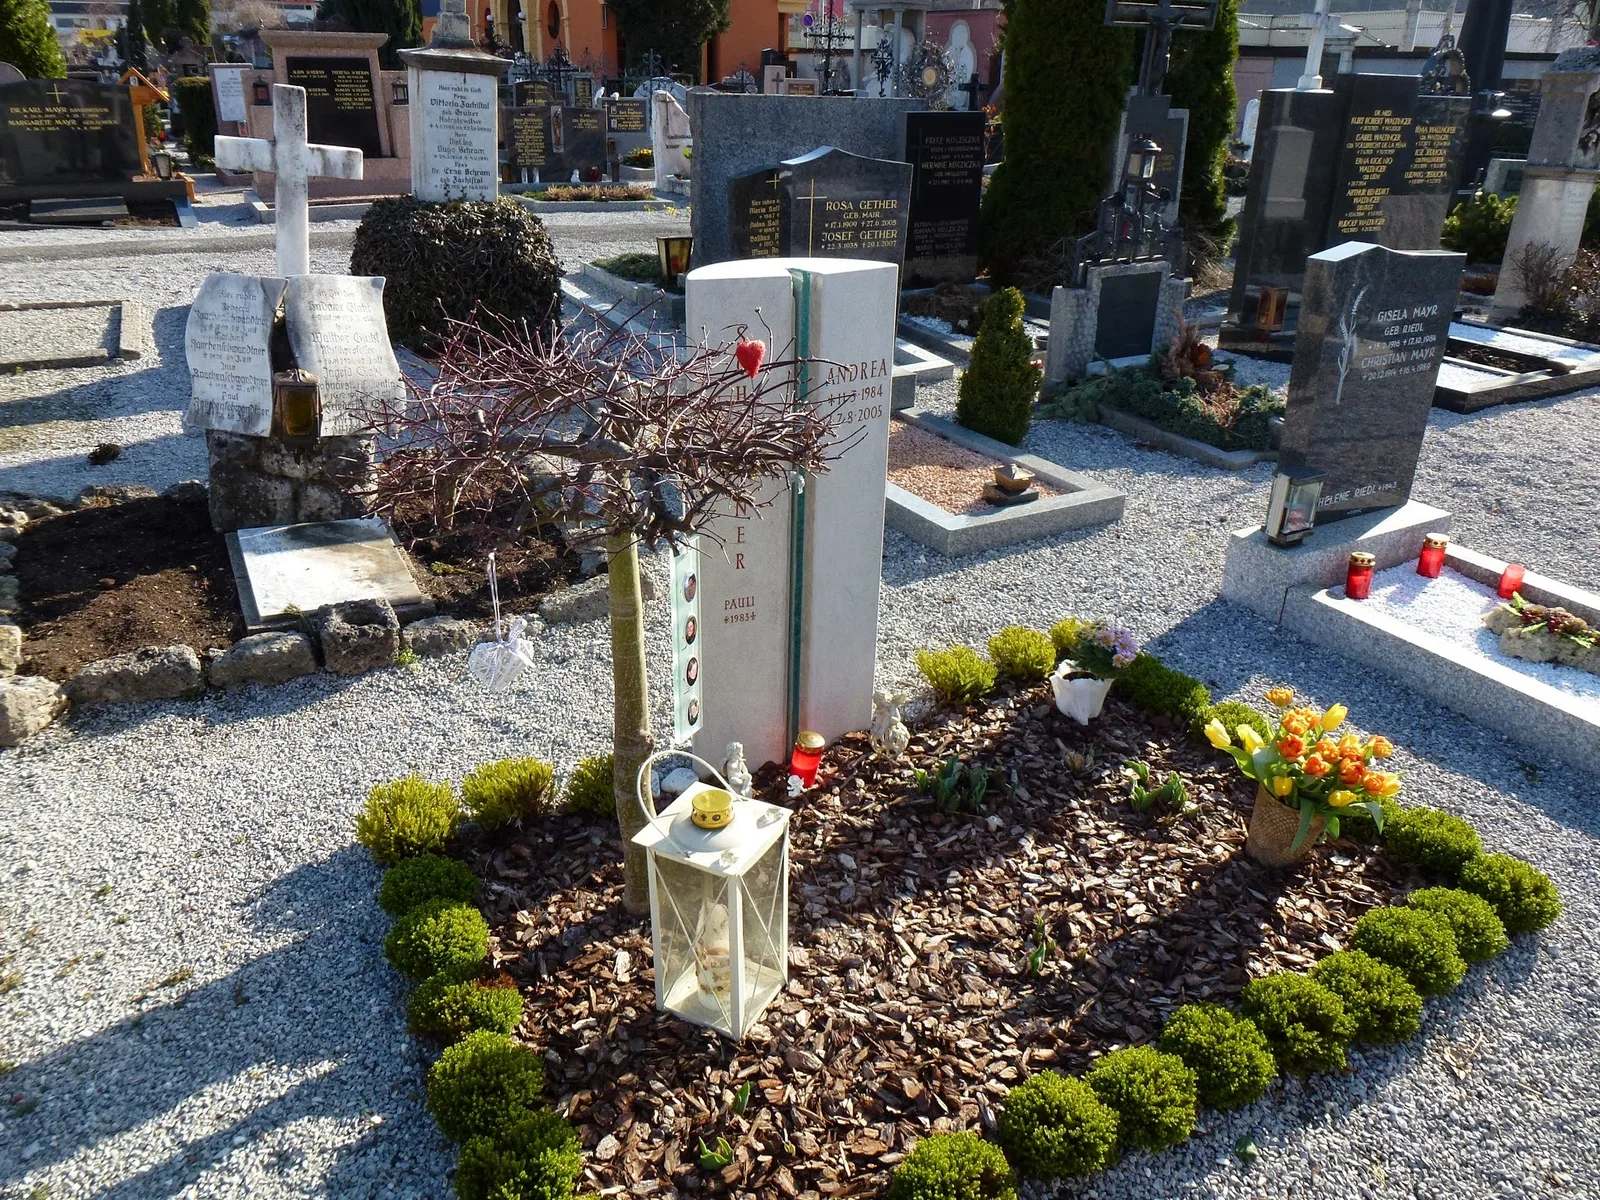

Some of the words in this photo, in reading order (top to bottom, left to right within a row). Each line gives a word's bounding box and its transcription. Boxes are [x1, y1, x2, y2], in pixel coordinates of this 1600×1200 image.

[826, 200, 854, 211] ROSA
[859, 199, 898, 210] GETHER
[862, 211, 880, 219] MAIR
[821, 231, 855, 242] JOSEF
[859, 229, 898, 240] GETHER
[1377, 309, 1408, 323] GISELA
[1412, 304, 1438, 319] MAYR
[1402, 322, 1424, 334] RIEDL
[1361, 351, 1407, 369] CHRISTIAN
[1411, 346, 1436, 361] MAYR
[826, 358, 887, 386] ANDREA
[1318, 490, 1351, 507] HELENE
[1354, 484, 1377, 498] RIEDL
[724, 596, 755, 610] PAULI
